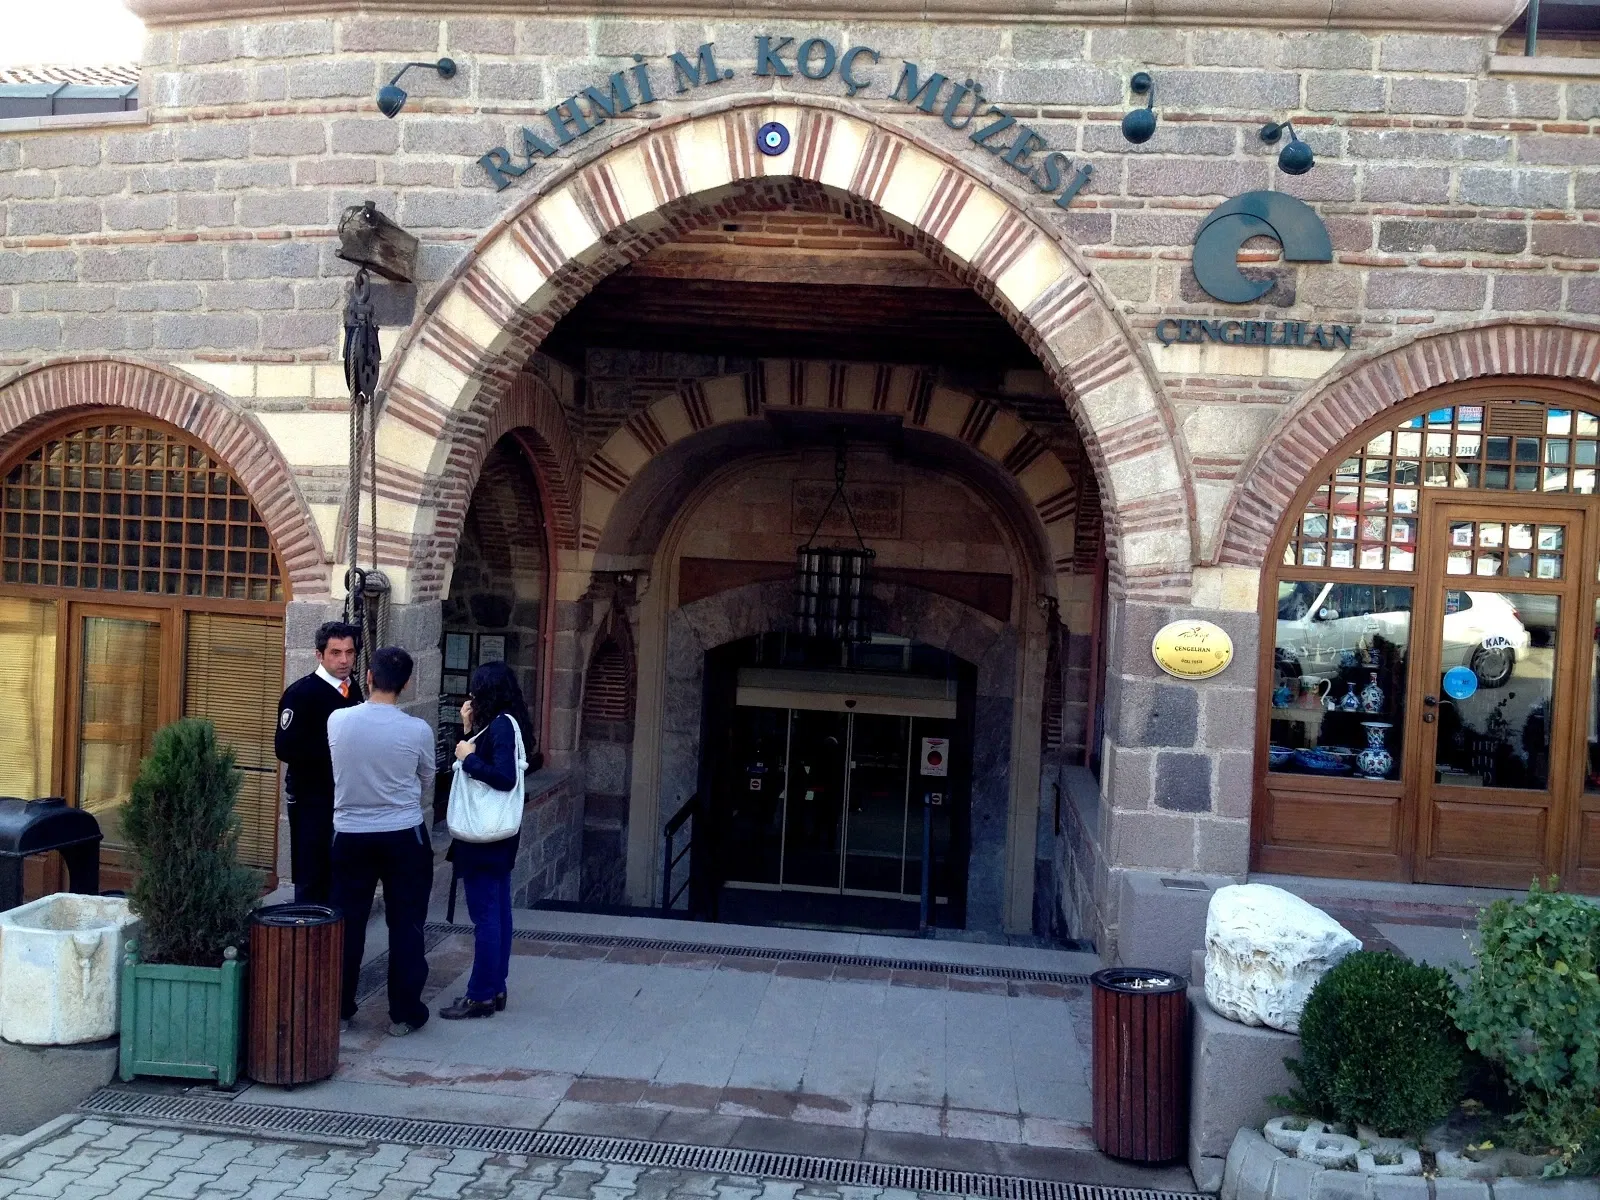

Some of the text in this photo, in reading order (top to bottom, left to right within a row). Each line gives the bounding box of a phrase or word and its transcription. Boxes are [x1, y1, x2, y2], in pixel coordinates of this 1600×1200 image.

[476, 35, 1094, 211] RAHMİ M. KOÇ MÜZESİ
[1155, 317, 1354, 350] ÇENGELHAN
